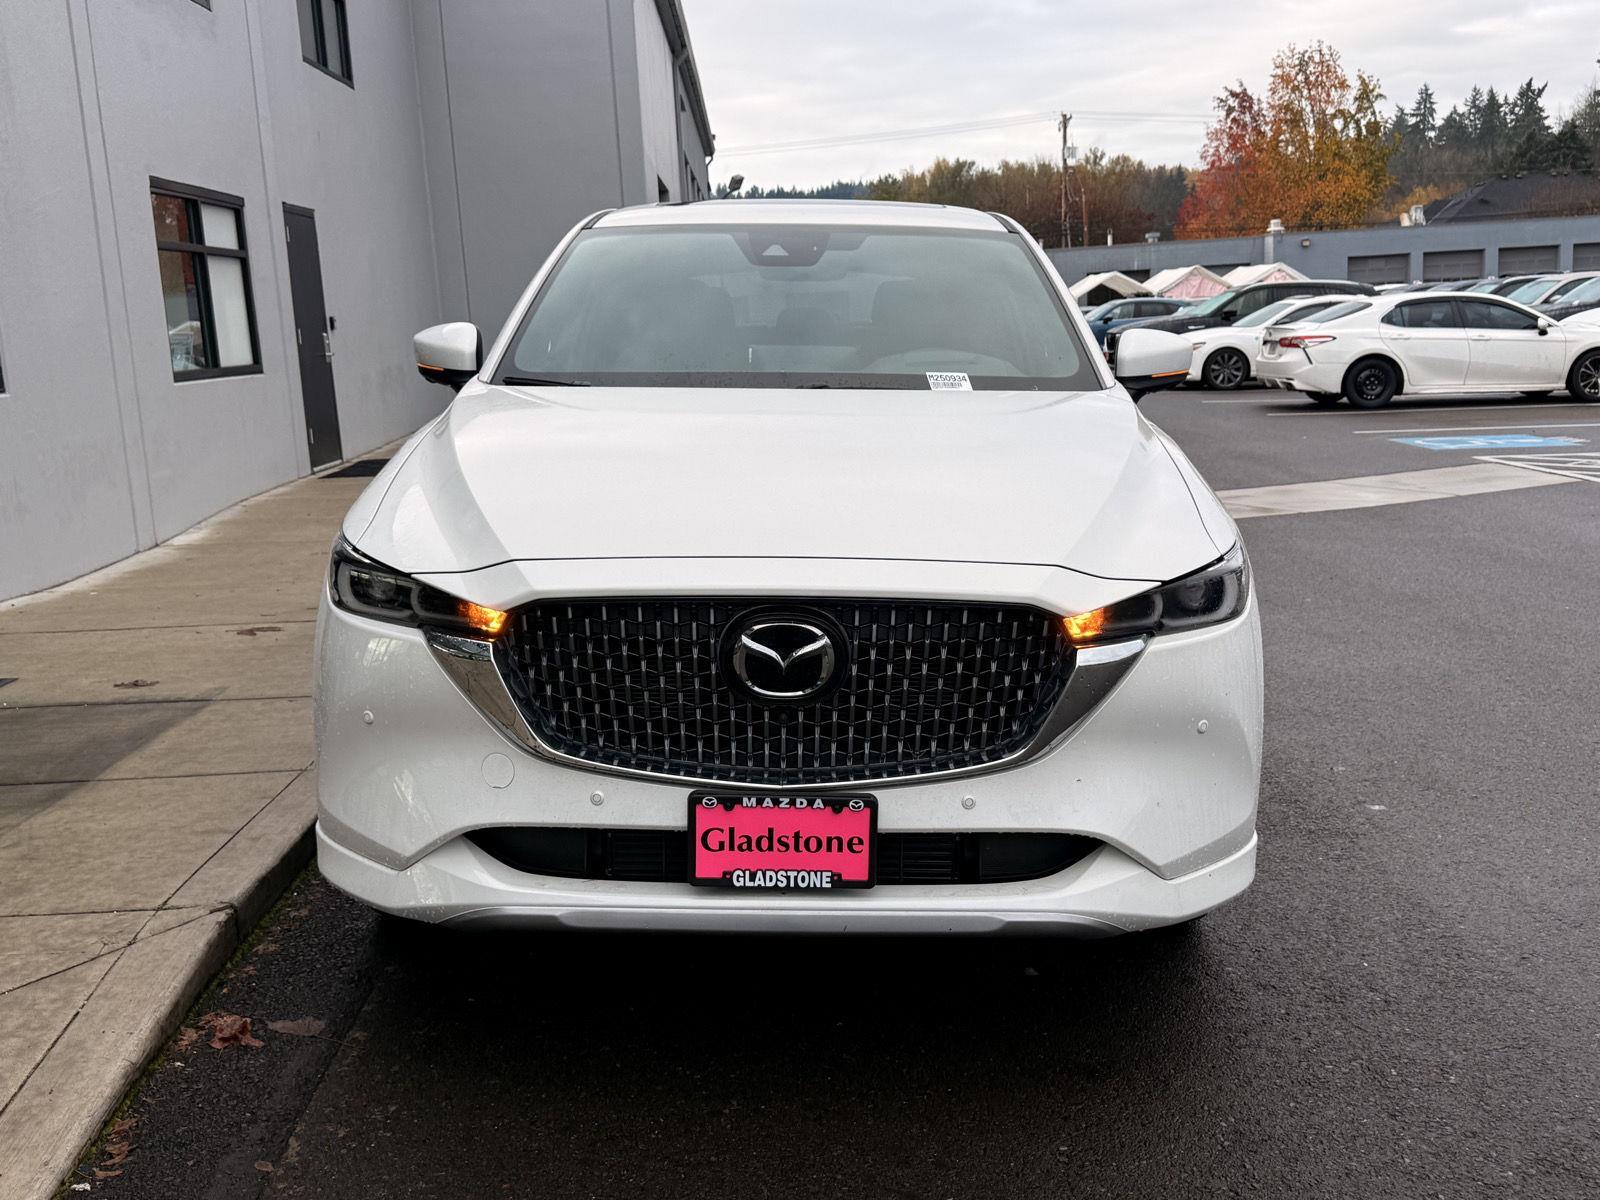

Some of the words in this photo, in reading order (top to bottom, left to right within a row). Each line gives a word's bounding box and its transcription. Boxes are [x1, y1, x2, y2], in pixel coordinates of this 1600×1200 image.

[742, 797, 825, 809] MAZDA
[700, 826, 865, 854] Gladstone
[732, 870, 832, 888] GLADSTONE
